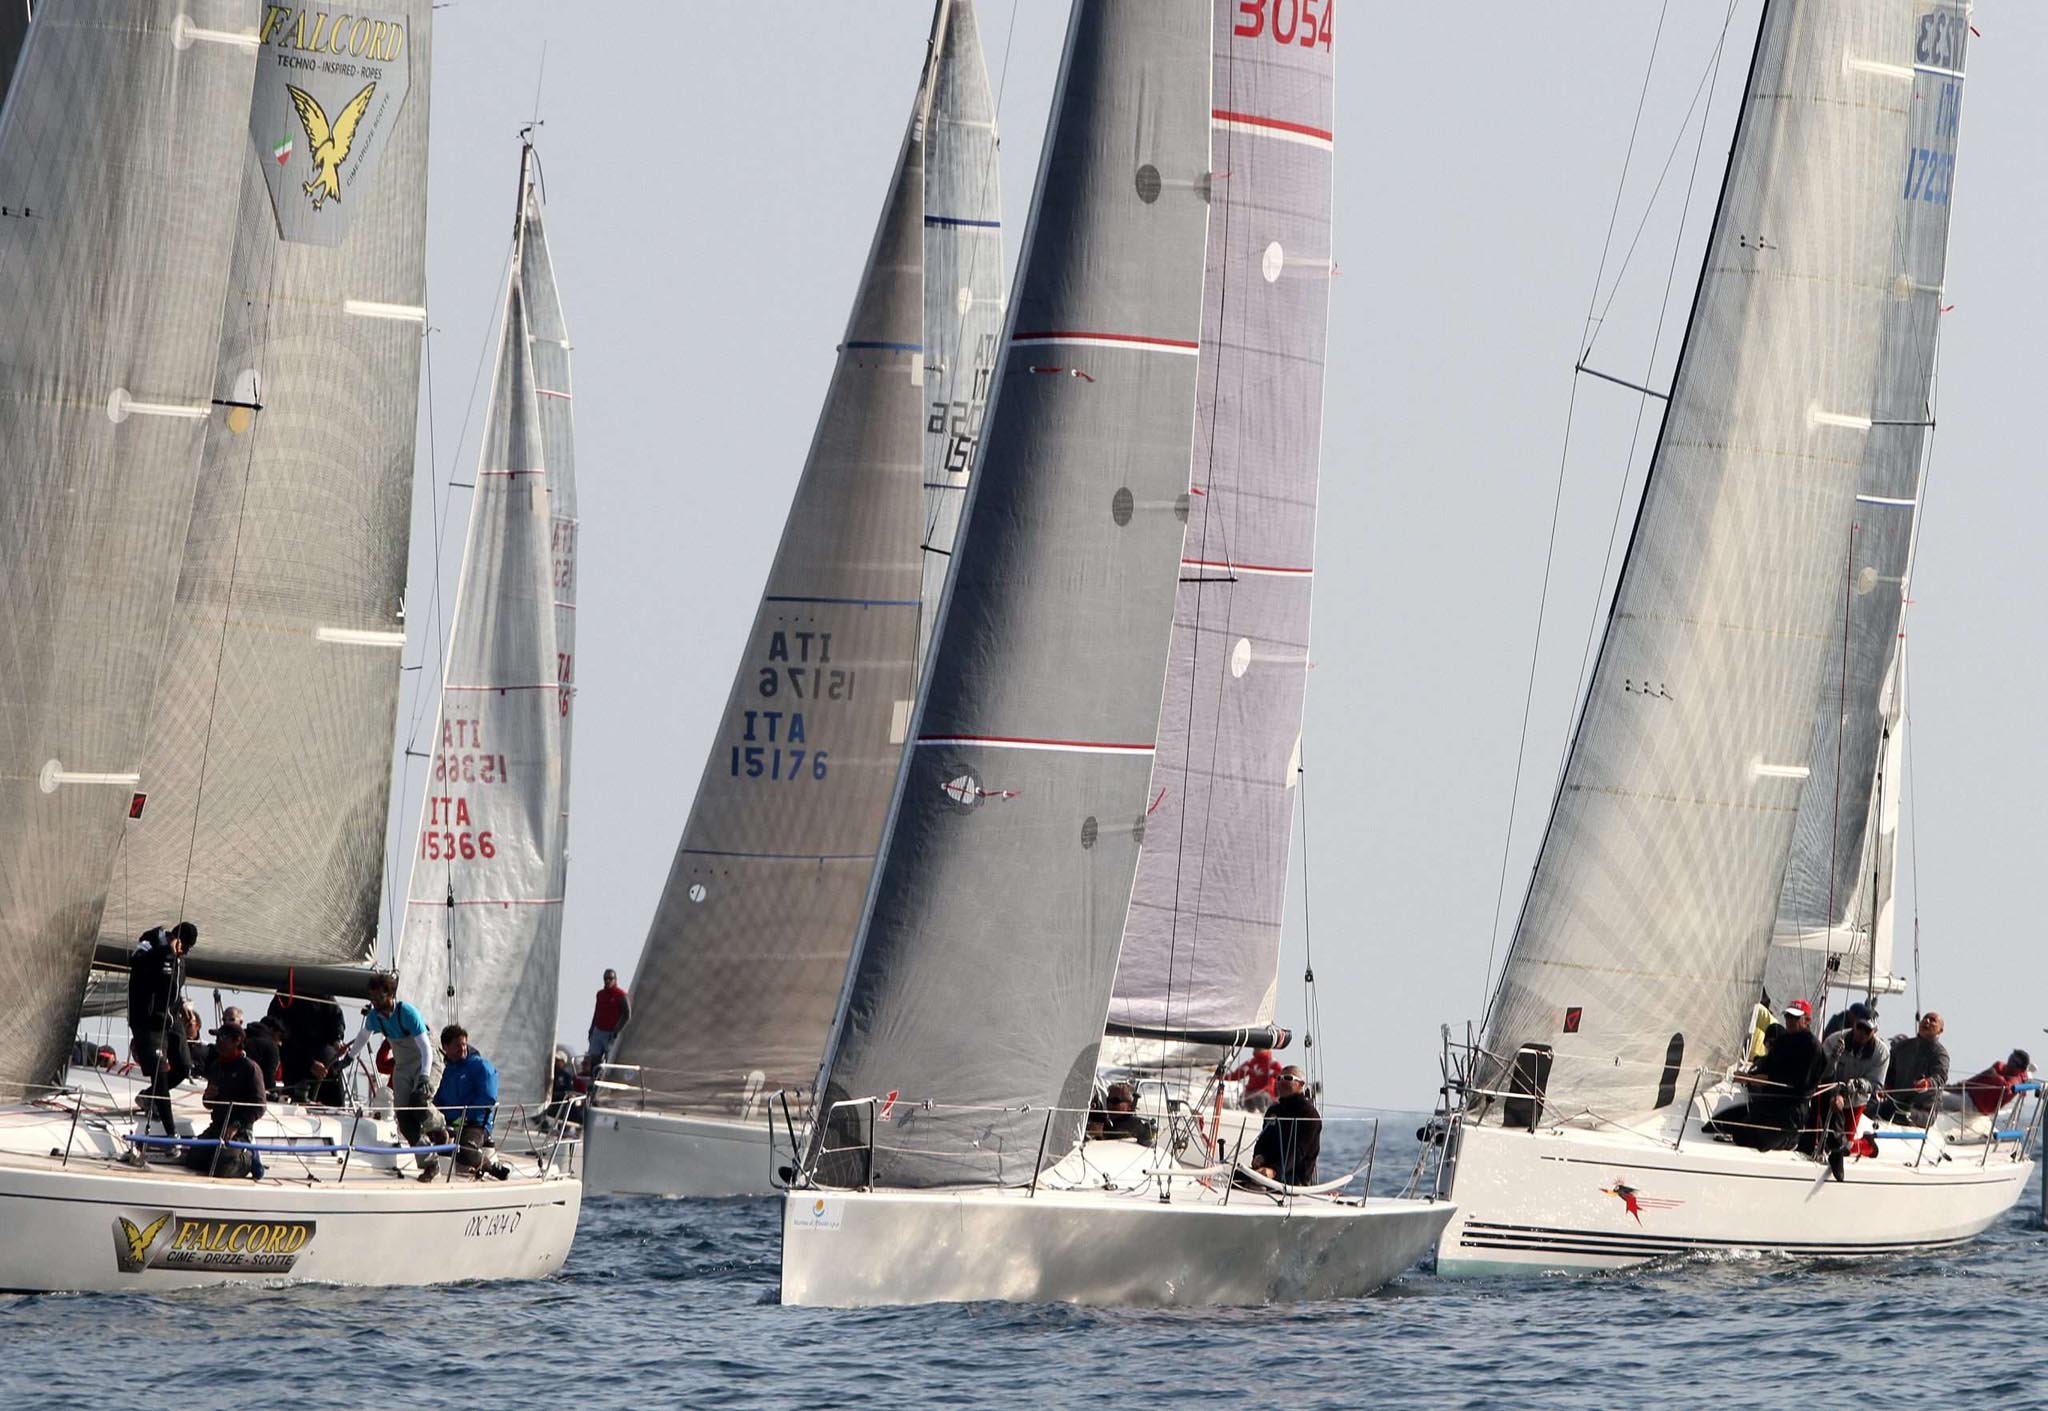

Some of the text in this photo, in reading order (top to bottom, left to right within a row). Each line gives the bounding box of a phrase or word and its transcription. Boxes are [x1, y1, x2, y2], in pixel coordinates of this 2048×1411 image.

[260, 5, 403, 62] FALCORD
[1233, 0, 1333, 53] 3054
[278, 54, 316, 71] TECHNO
[322, 61, 356, 77] INSPIRED
[361, 66, 382, 80] ROPES
[972, 368, 990, 401] IT
[743, 710, 805, 743] ITA
[731, 746, 829, 781] 15176
[430, 796, 471, 826] ITA
[421, 831, 496, 861] 15366
[171, 1221, 307, 1254] FALCORD
[166, 1251, 196, 1262] CIME
[203, 1253, 245, 1265] DRIZZE
[251, 1254, 295, 1266] SCOTTE
